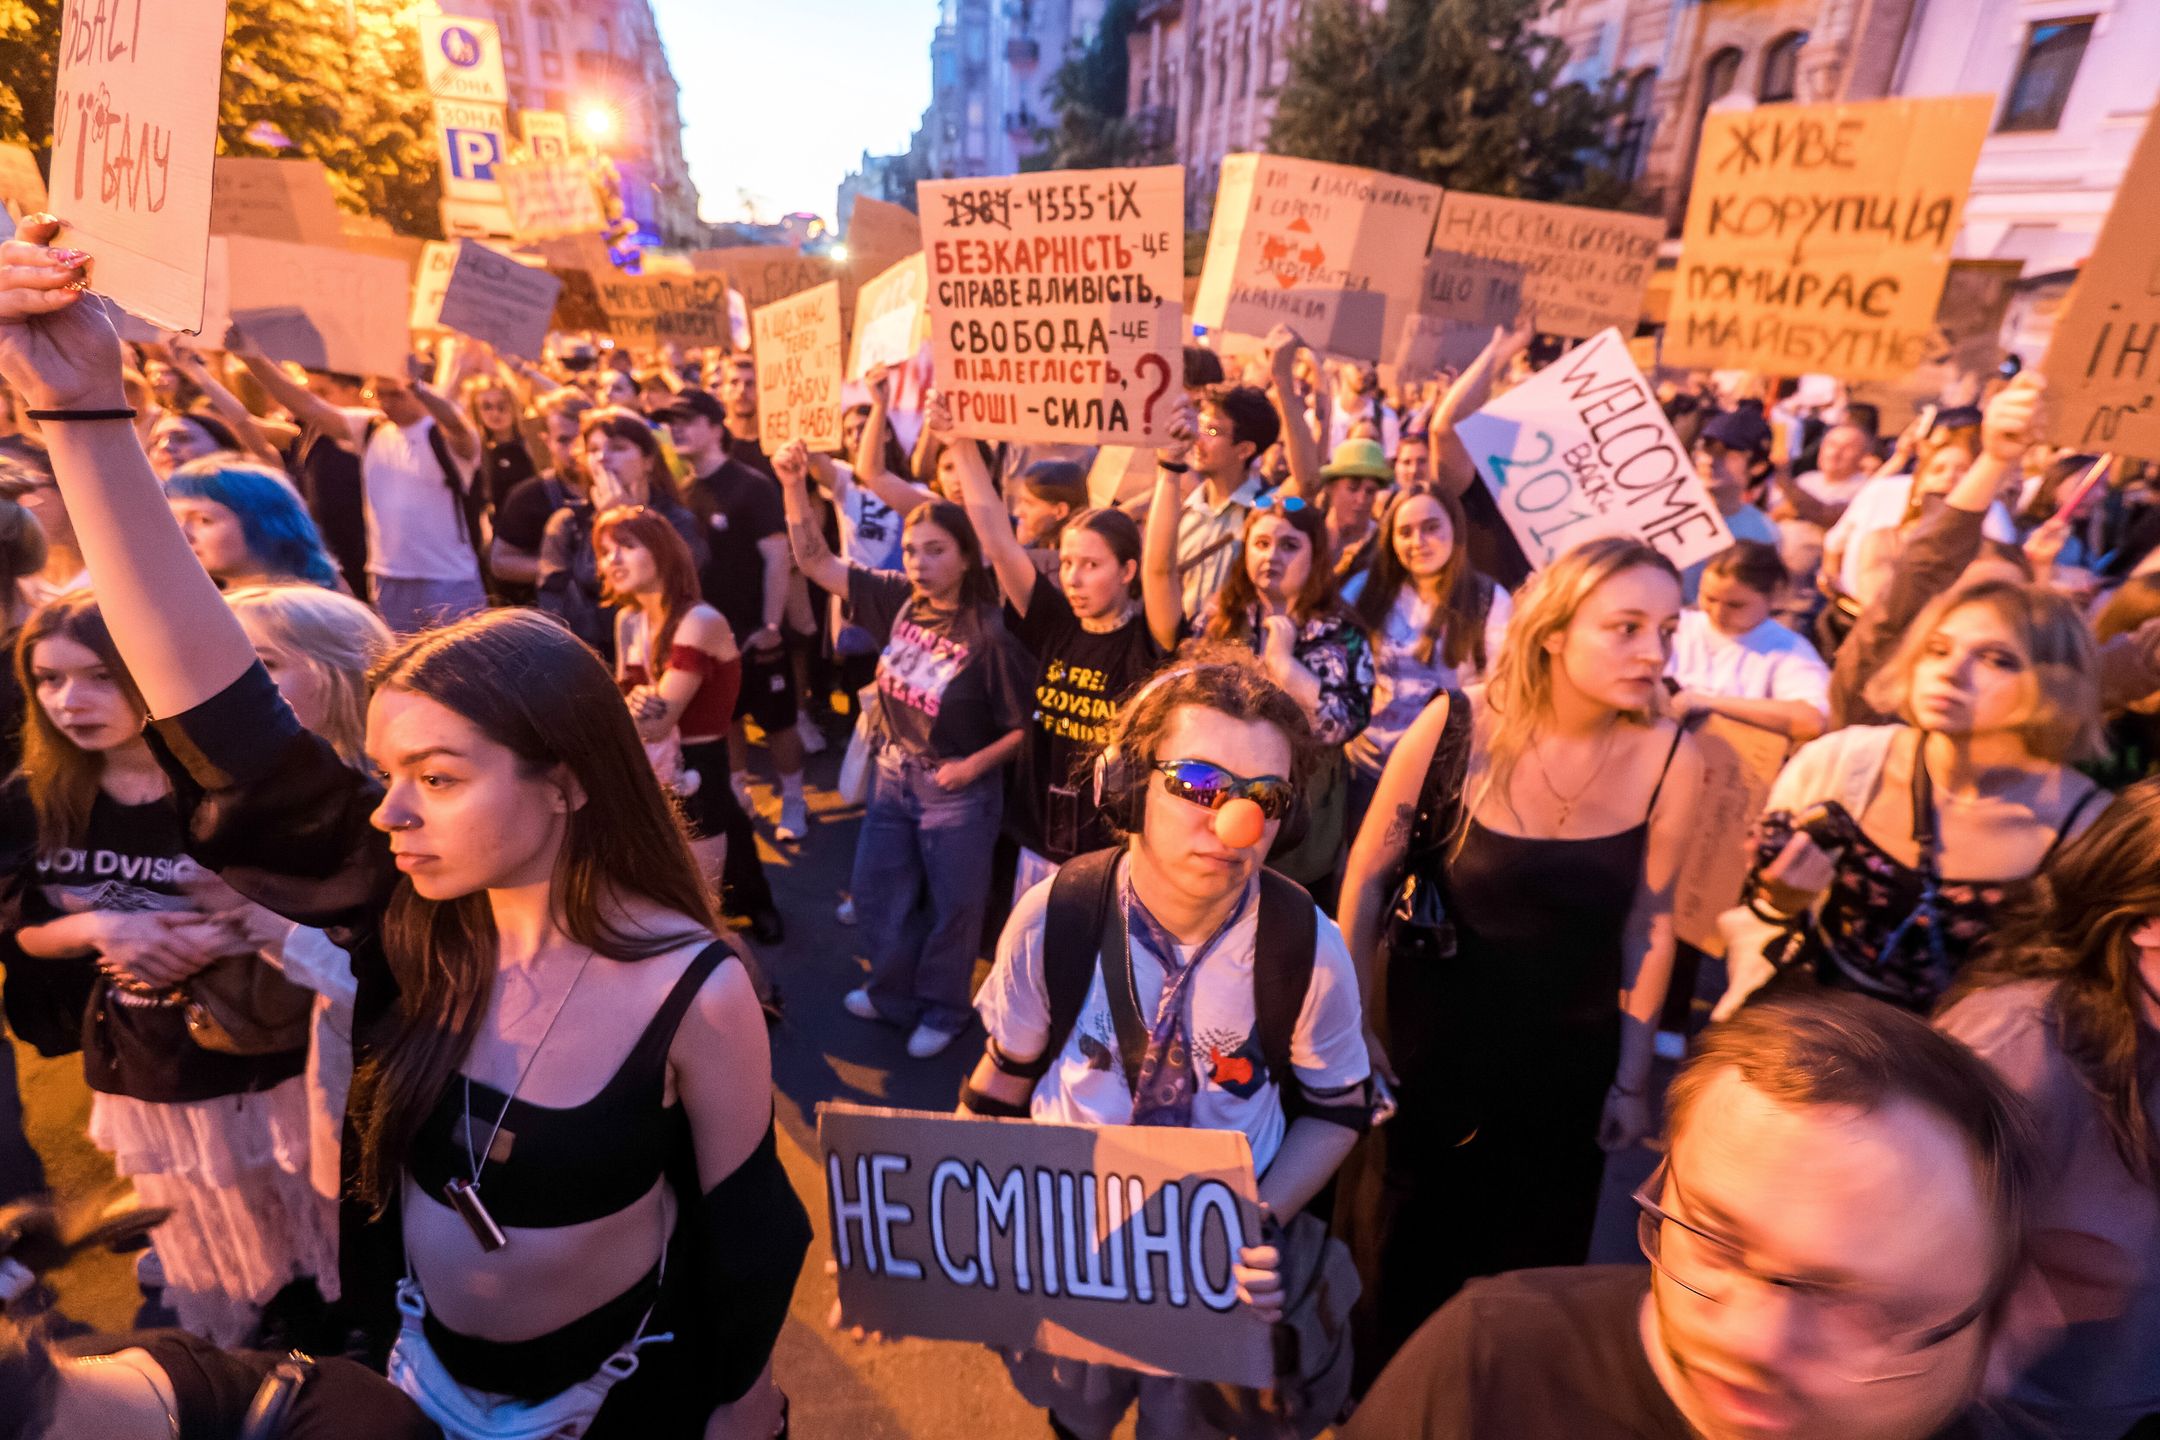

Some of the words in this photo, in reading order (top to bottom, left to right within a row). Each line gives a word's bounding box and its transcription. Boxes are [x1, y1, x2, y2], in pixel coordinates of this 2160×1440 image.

[458, 130, 494, 180] P
[1716, 117, 1865, 176] ЖИВЕ
[1706, 189, 1955, 264] КОРУПЦІЯ
[938, 273, 1163, 309] СПРАВЕДЛИВІСТЬ,
[1562, 337, 1719, 544] WELCOME
[1487, 430, 1591, 562] 201
[827, 1151, 926, 1280] НЕ
[929, 1156, 1248, 1314] СМІШНО
